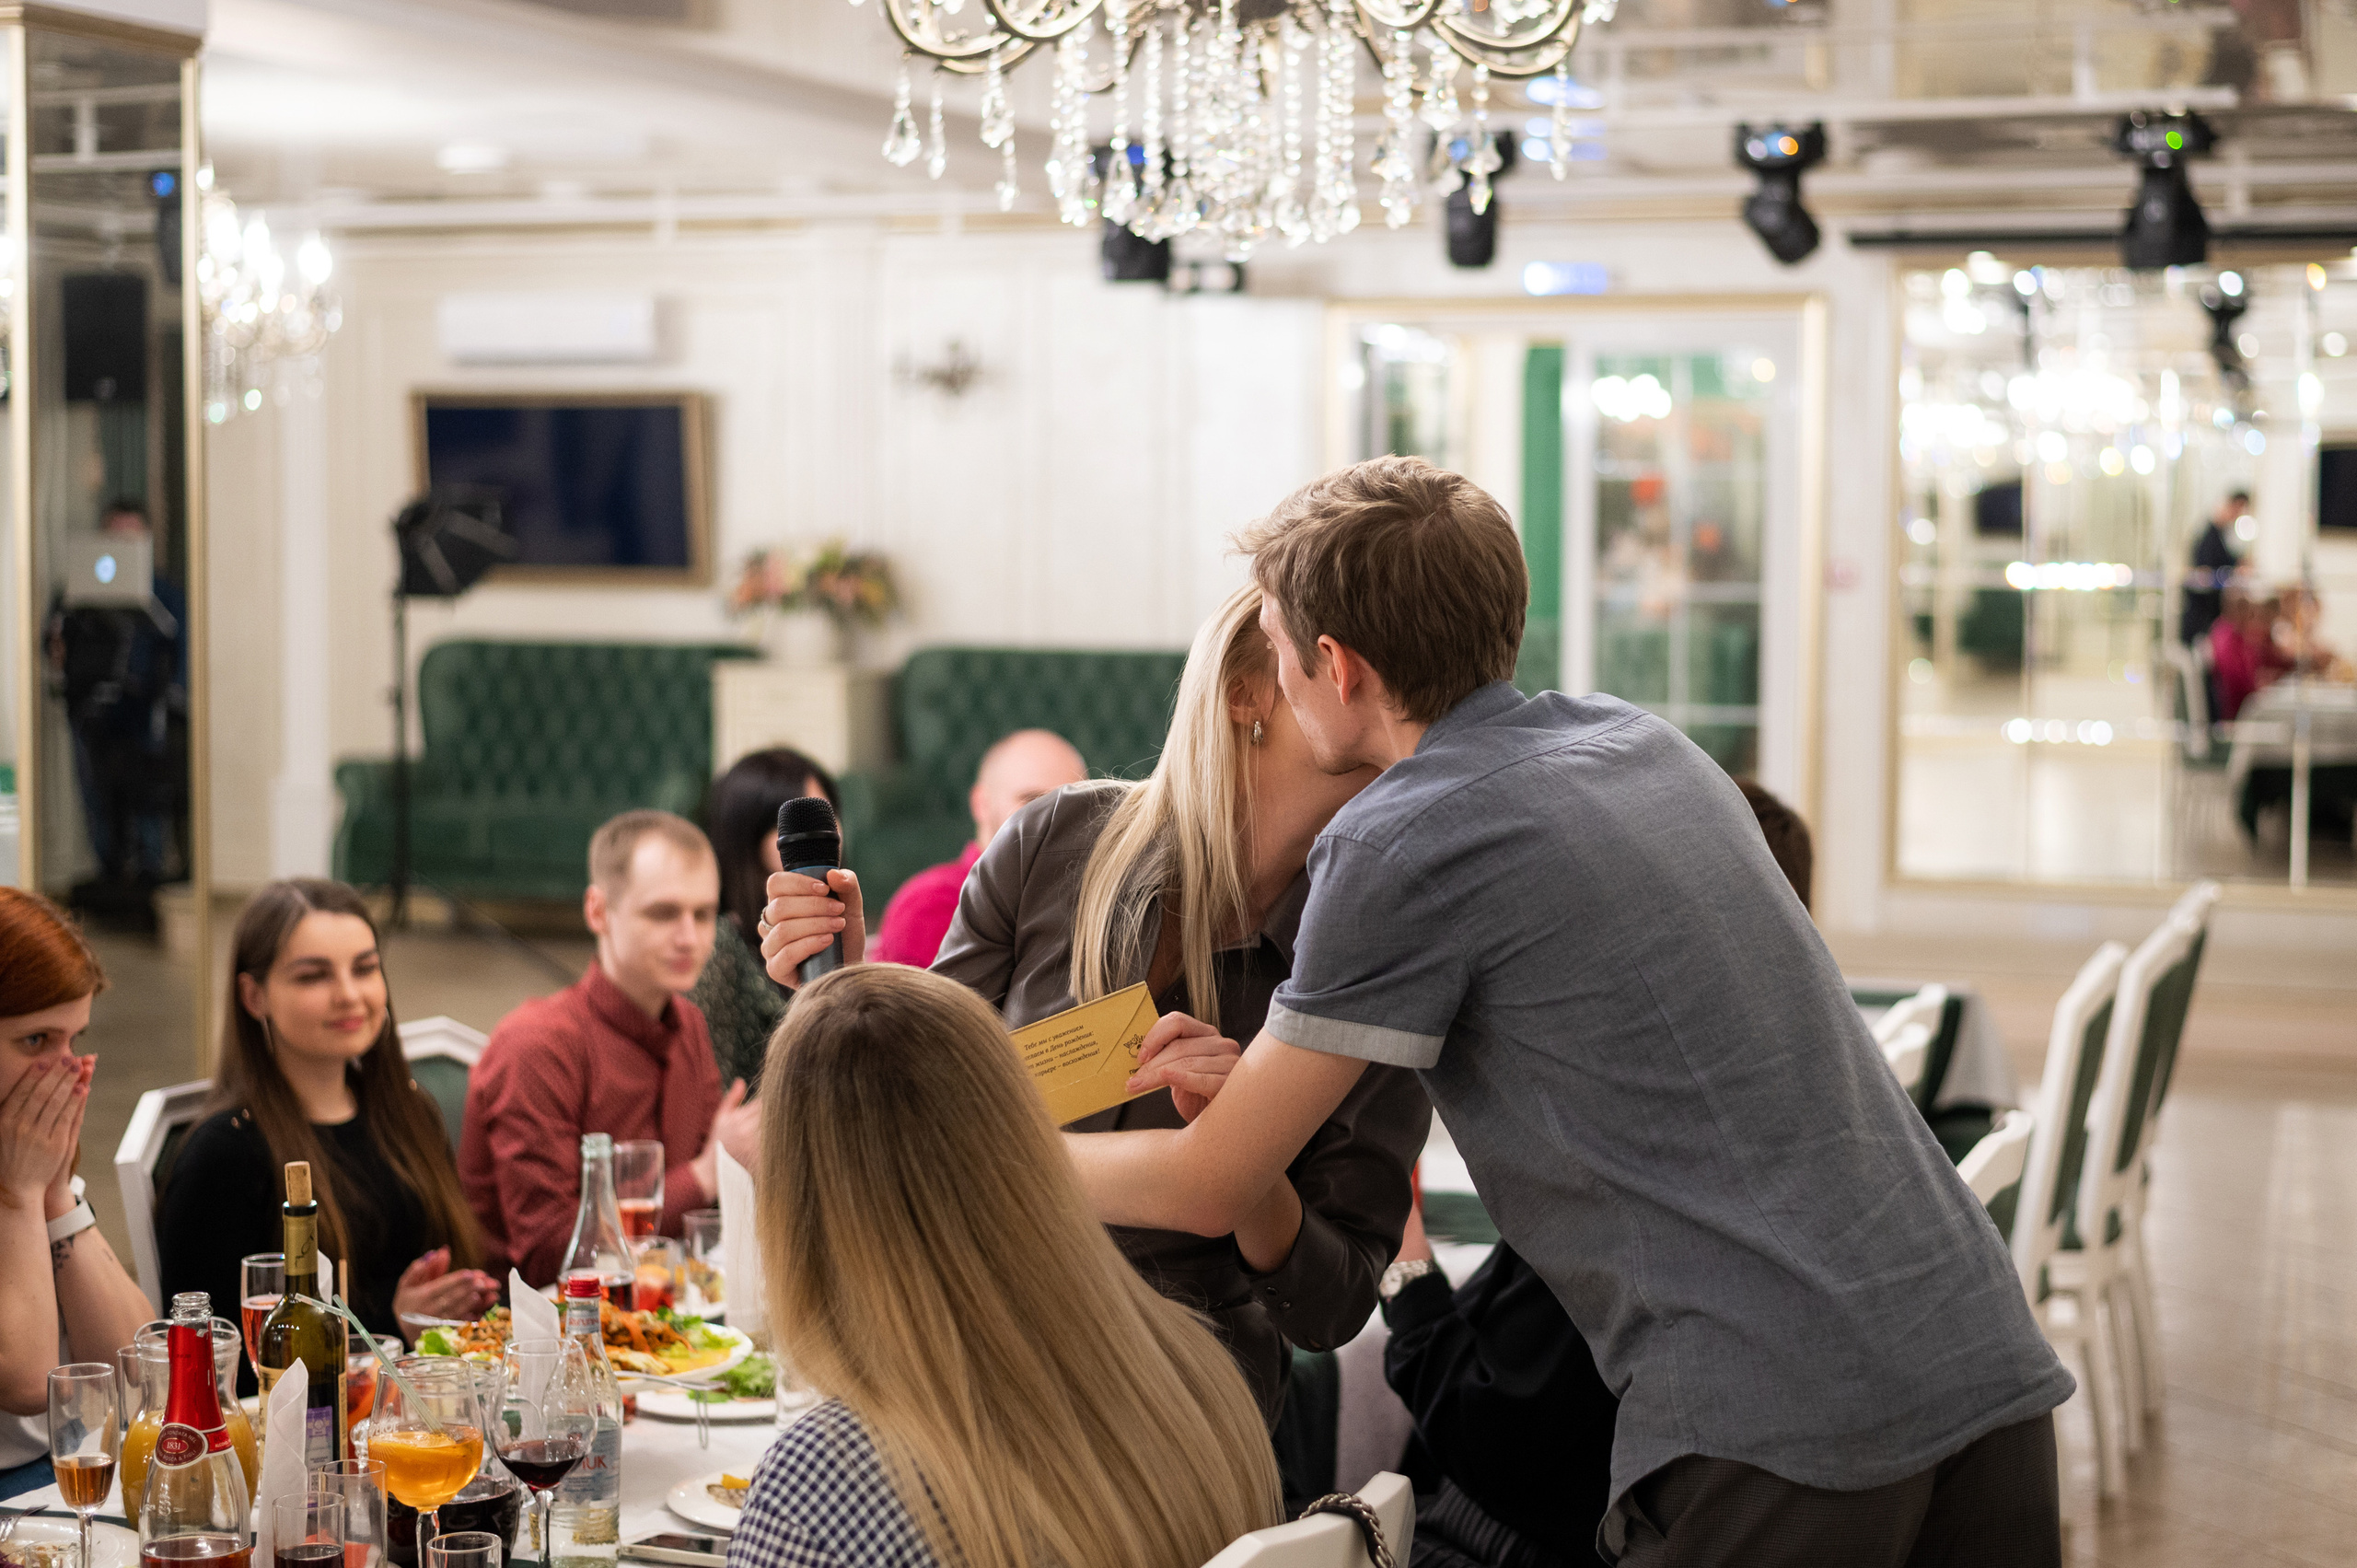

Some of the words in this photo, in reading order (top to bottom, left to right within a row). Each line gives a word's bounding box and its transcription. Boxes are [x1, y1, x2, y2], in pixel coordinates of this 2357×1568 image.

[1024, 1041, 1038, 1051] Тебе
[1052, 1025, 1085, 1041] уважением
[1050, 1042, 1064, 1052] День
[1064, 1031, 1095, 1047] рождения:
[1035, 1057, 1054, 1068] жизни
[1059, 1040, 1098, 1058] наслаждения,
[1062, 1048, 1101, 1067] восхождения!
[167, 1441, 181, 1450] 1831
